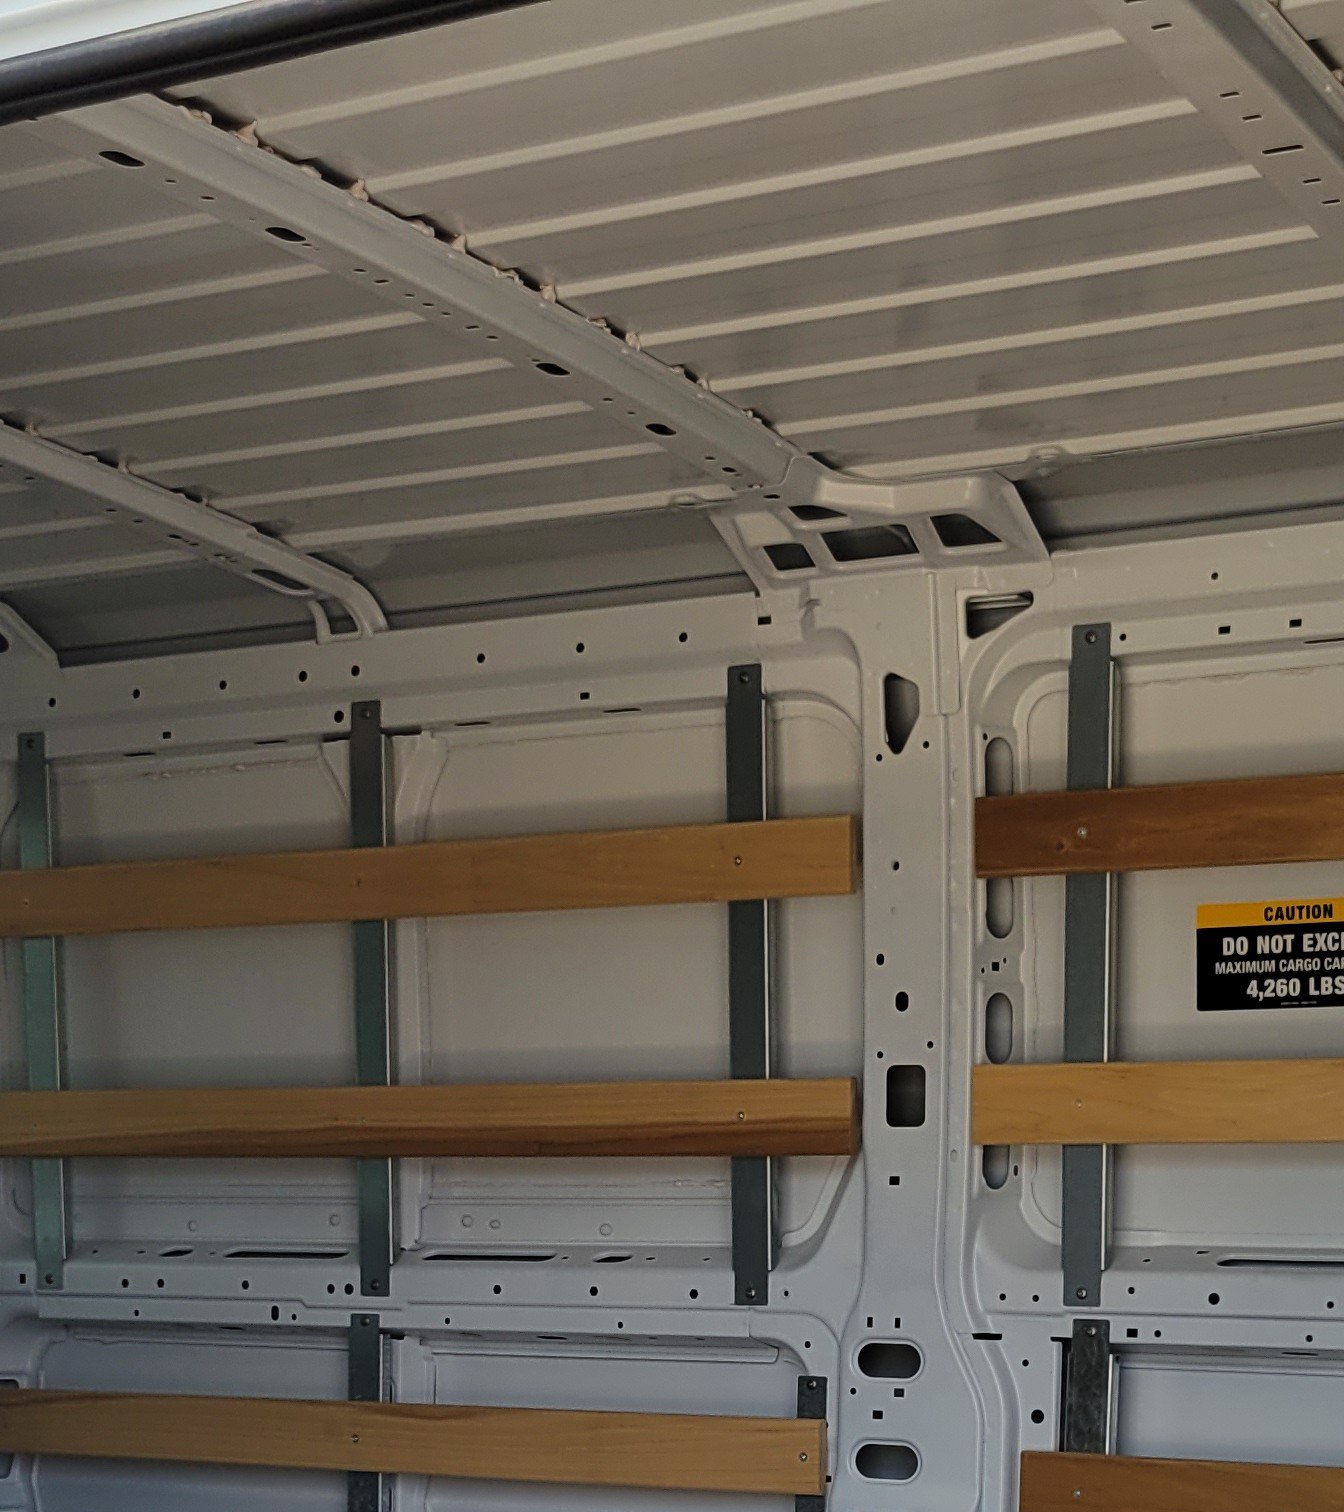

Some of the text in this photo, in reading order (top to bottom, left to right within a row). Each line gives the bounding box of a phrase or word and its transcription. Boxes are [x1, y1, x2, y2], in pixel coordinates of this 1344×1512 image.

[1264, 904, 1333, 921] CAUTION
[1222, 936, 1249, 956] DO
[1256, 934, 1295, 954] NOT
[1215, 960, 1276, 974] MAXIMUM
[1279, 957, 1321, 972] CARGO
[1246, 978, 1301, 1000] 4,260
